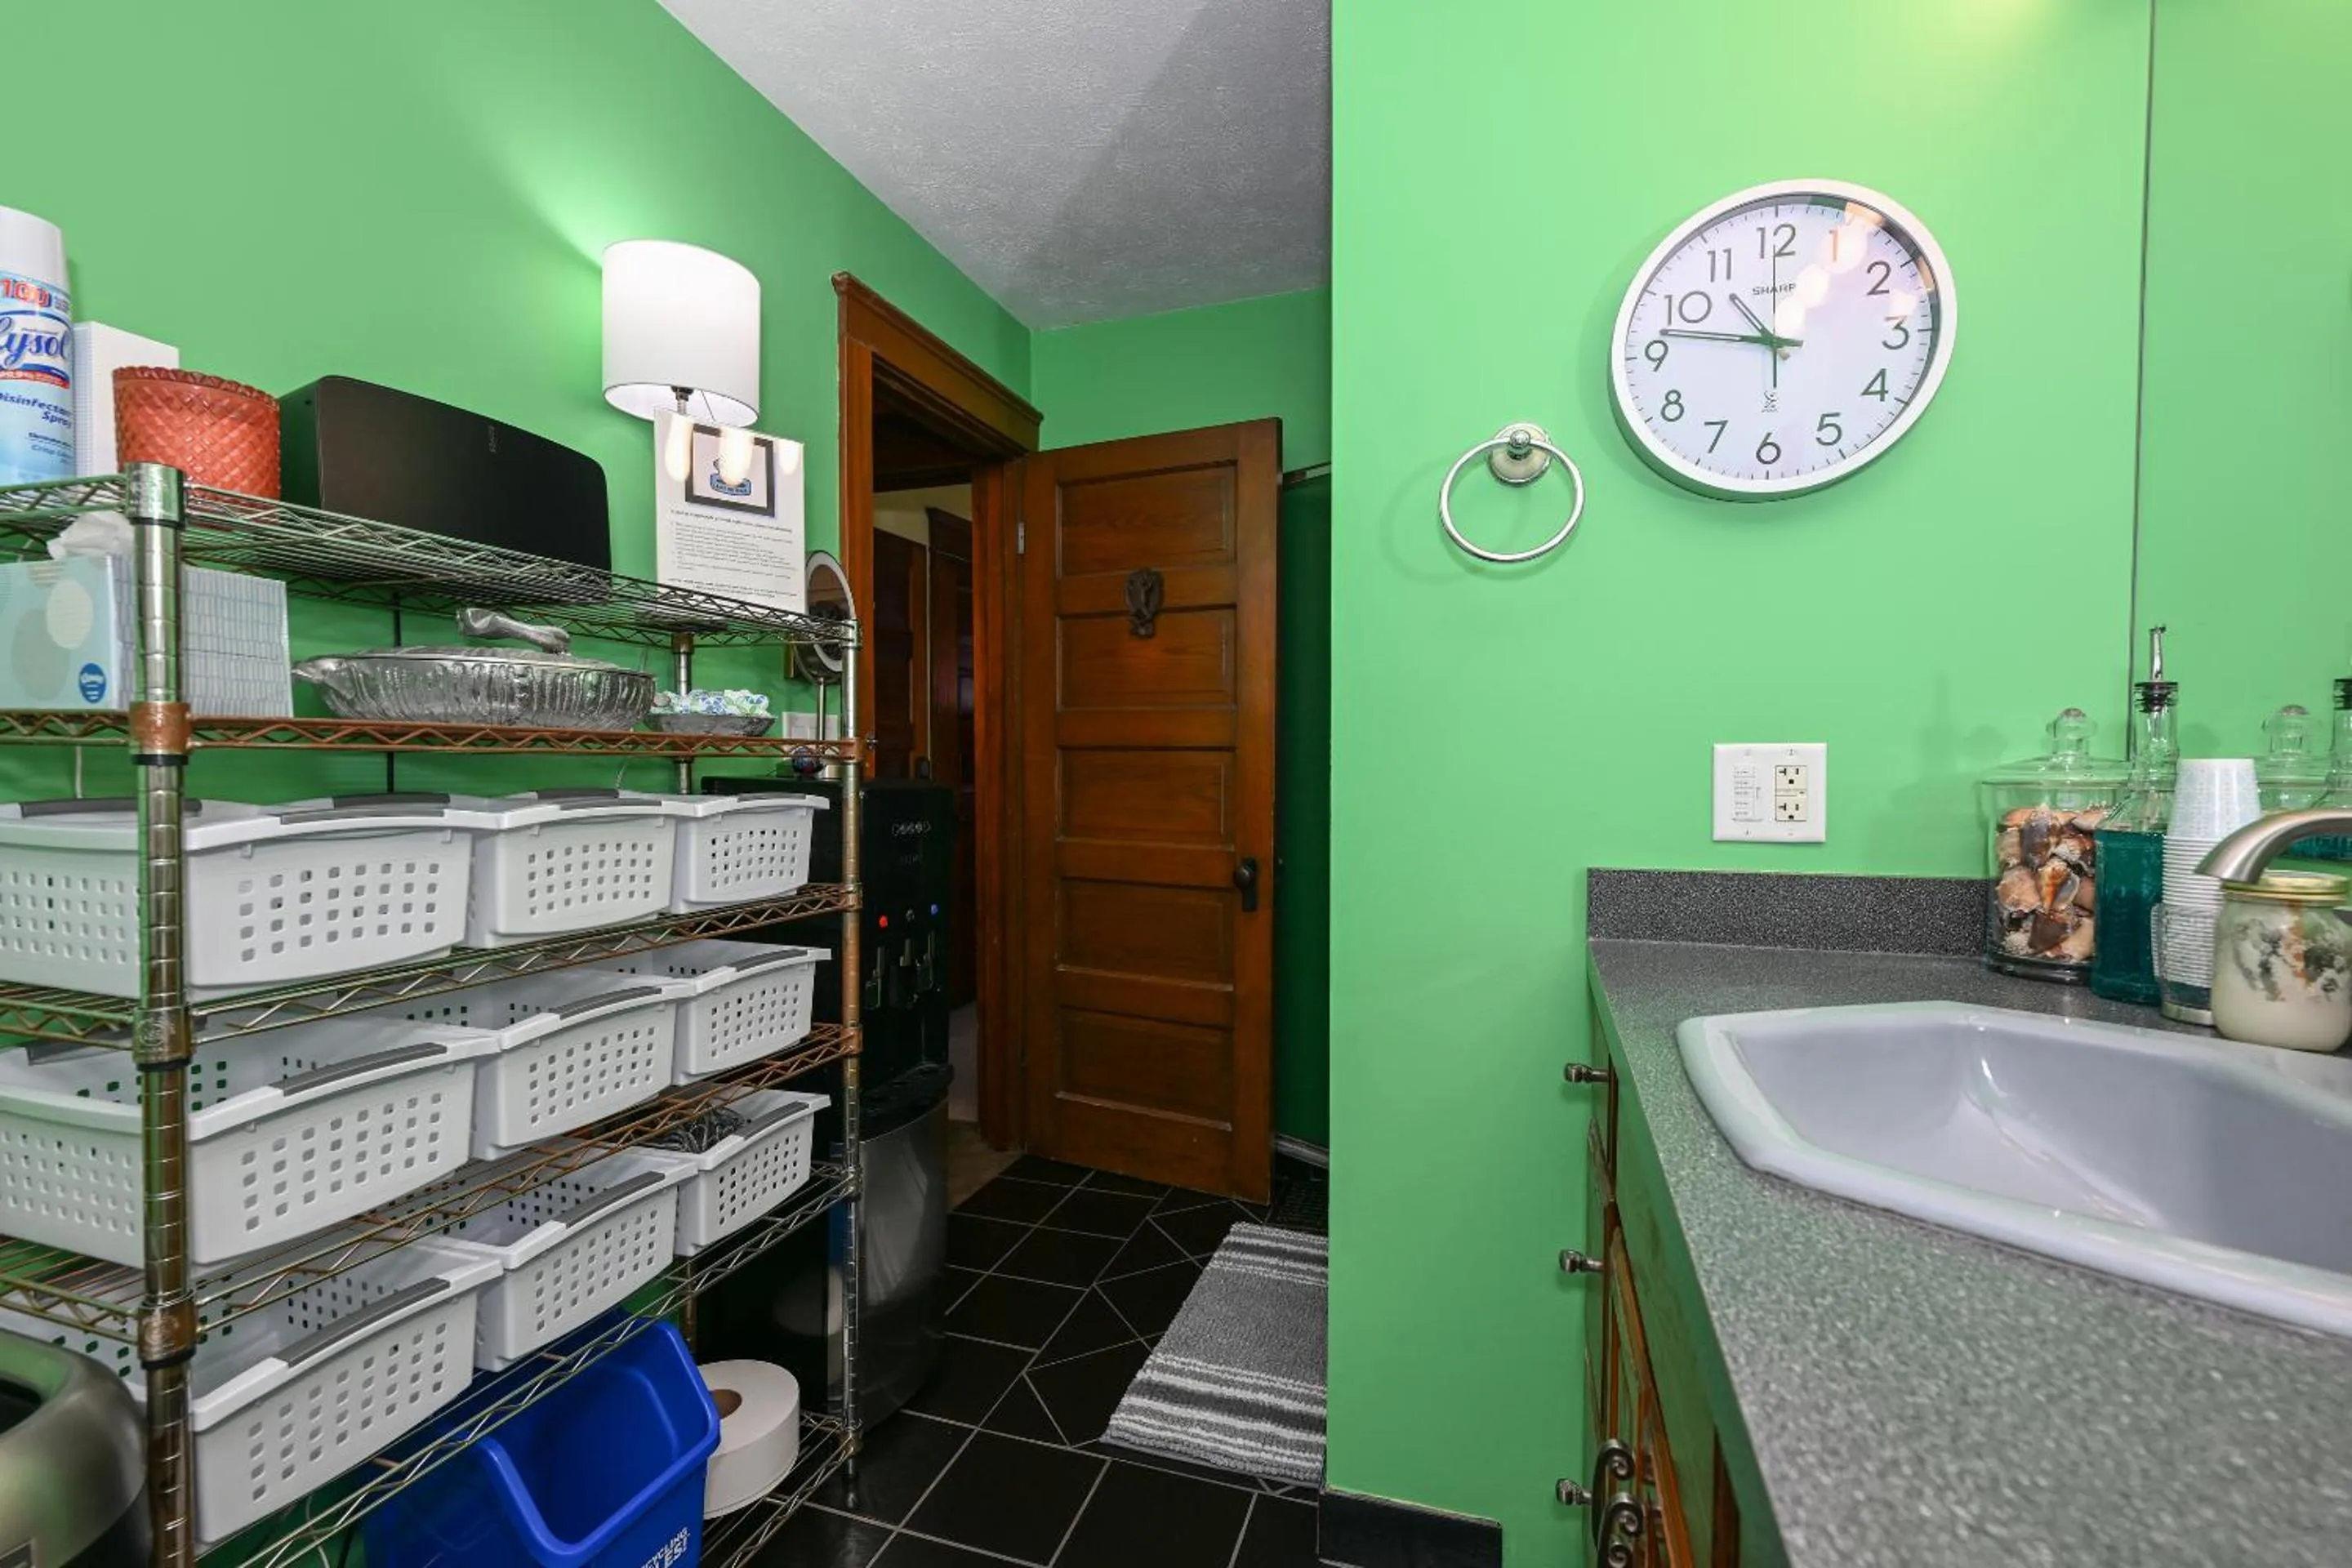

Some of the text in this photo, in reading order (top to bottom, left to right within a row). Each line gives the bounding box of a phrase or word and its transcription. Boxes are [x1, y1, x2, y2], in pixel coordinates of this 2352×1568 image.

[1756, 223, 1797, 260] 12
[1828, 229, 1838, 262] 1
[1707, 247, 1733, 283] 11
[1866, 261, 1891, 296] 2
[1752, 283, 1797, 296] SHARP
[1664, 290, 1713, 326] 10
[1882, 315, 1909, 350] 3
[1644, 339, 1669, 372] 9
[1860, 368, 1889, 402] 4
[1659, 389, 1686, 422] 8
[1704, 420, 1729, 454] 7
[1815, 412, 1842, 447] 5
[1756, 432, 1782, 466] 6
